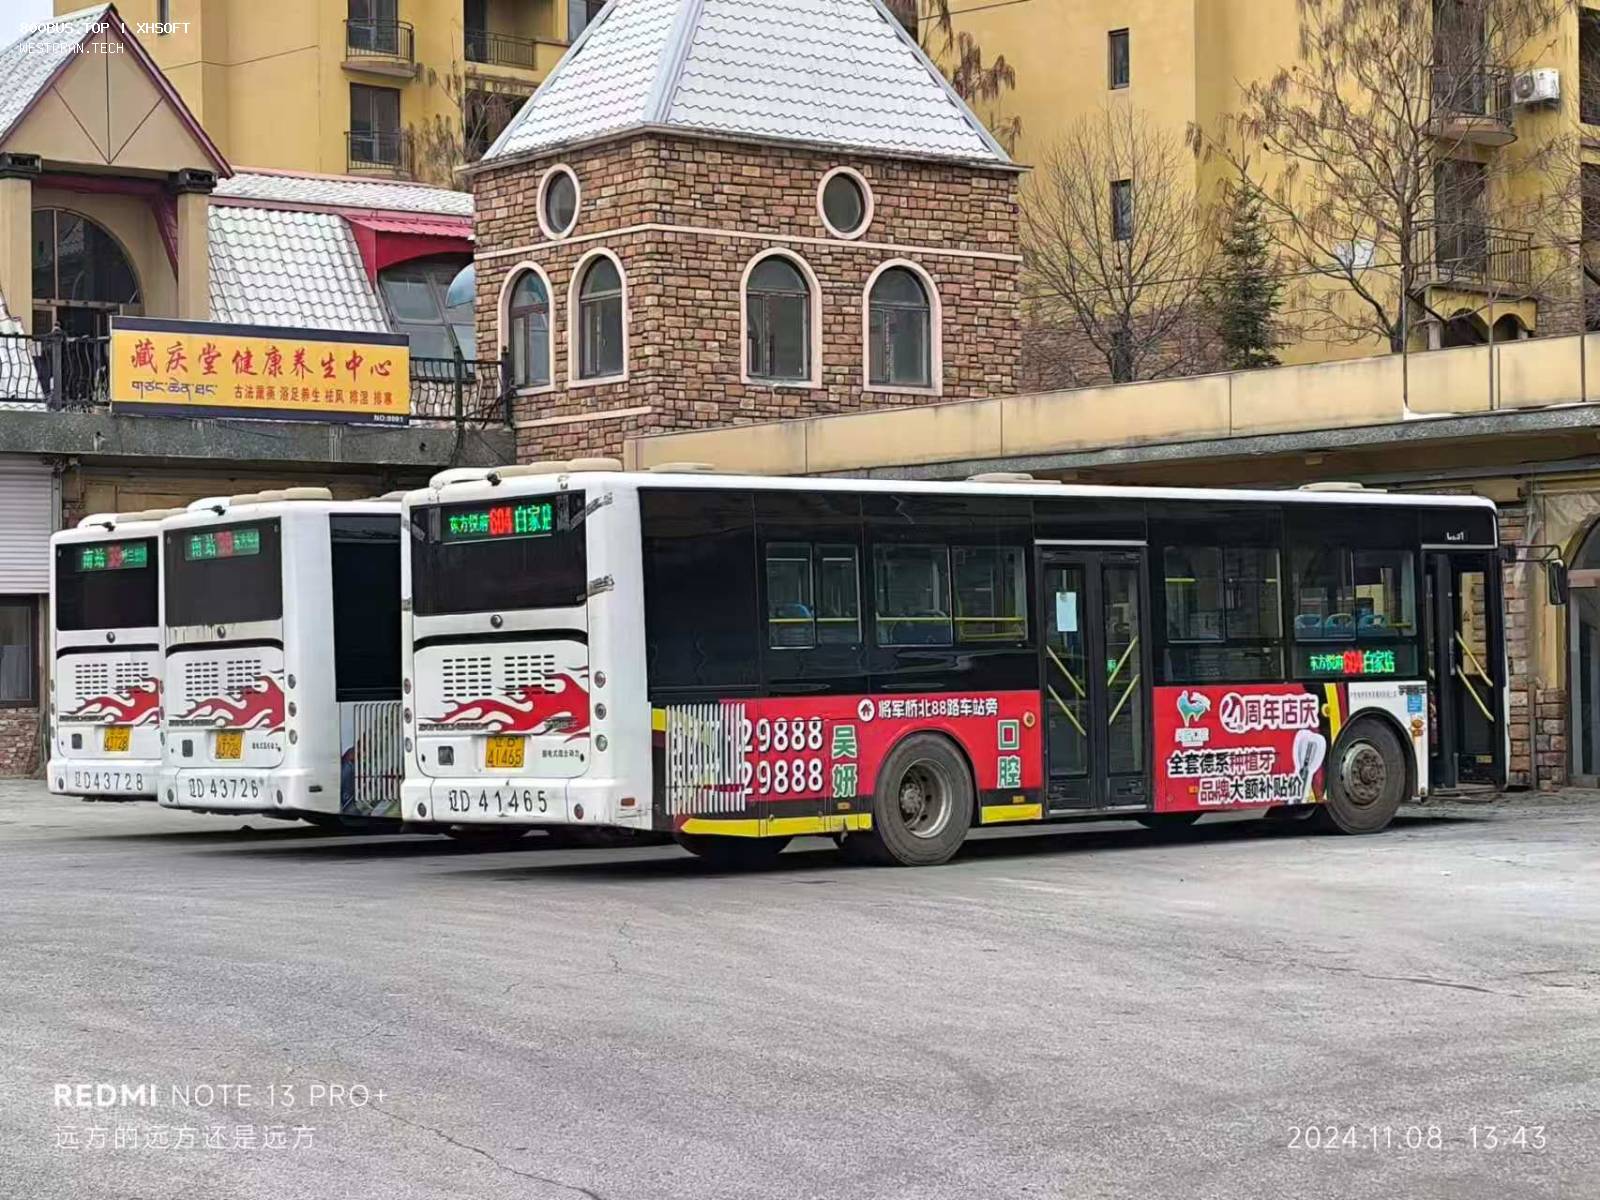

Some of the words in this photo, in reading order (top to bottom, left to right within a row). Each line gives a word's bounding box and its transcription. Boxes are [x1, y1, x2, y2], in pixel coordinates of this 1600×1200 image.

[878, 698, 998, 718] 将军桥北88路车站旁
[487, 749, 523, 766] 41465
[1169, 752, 1275, 776] 全套德系种植牙
